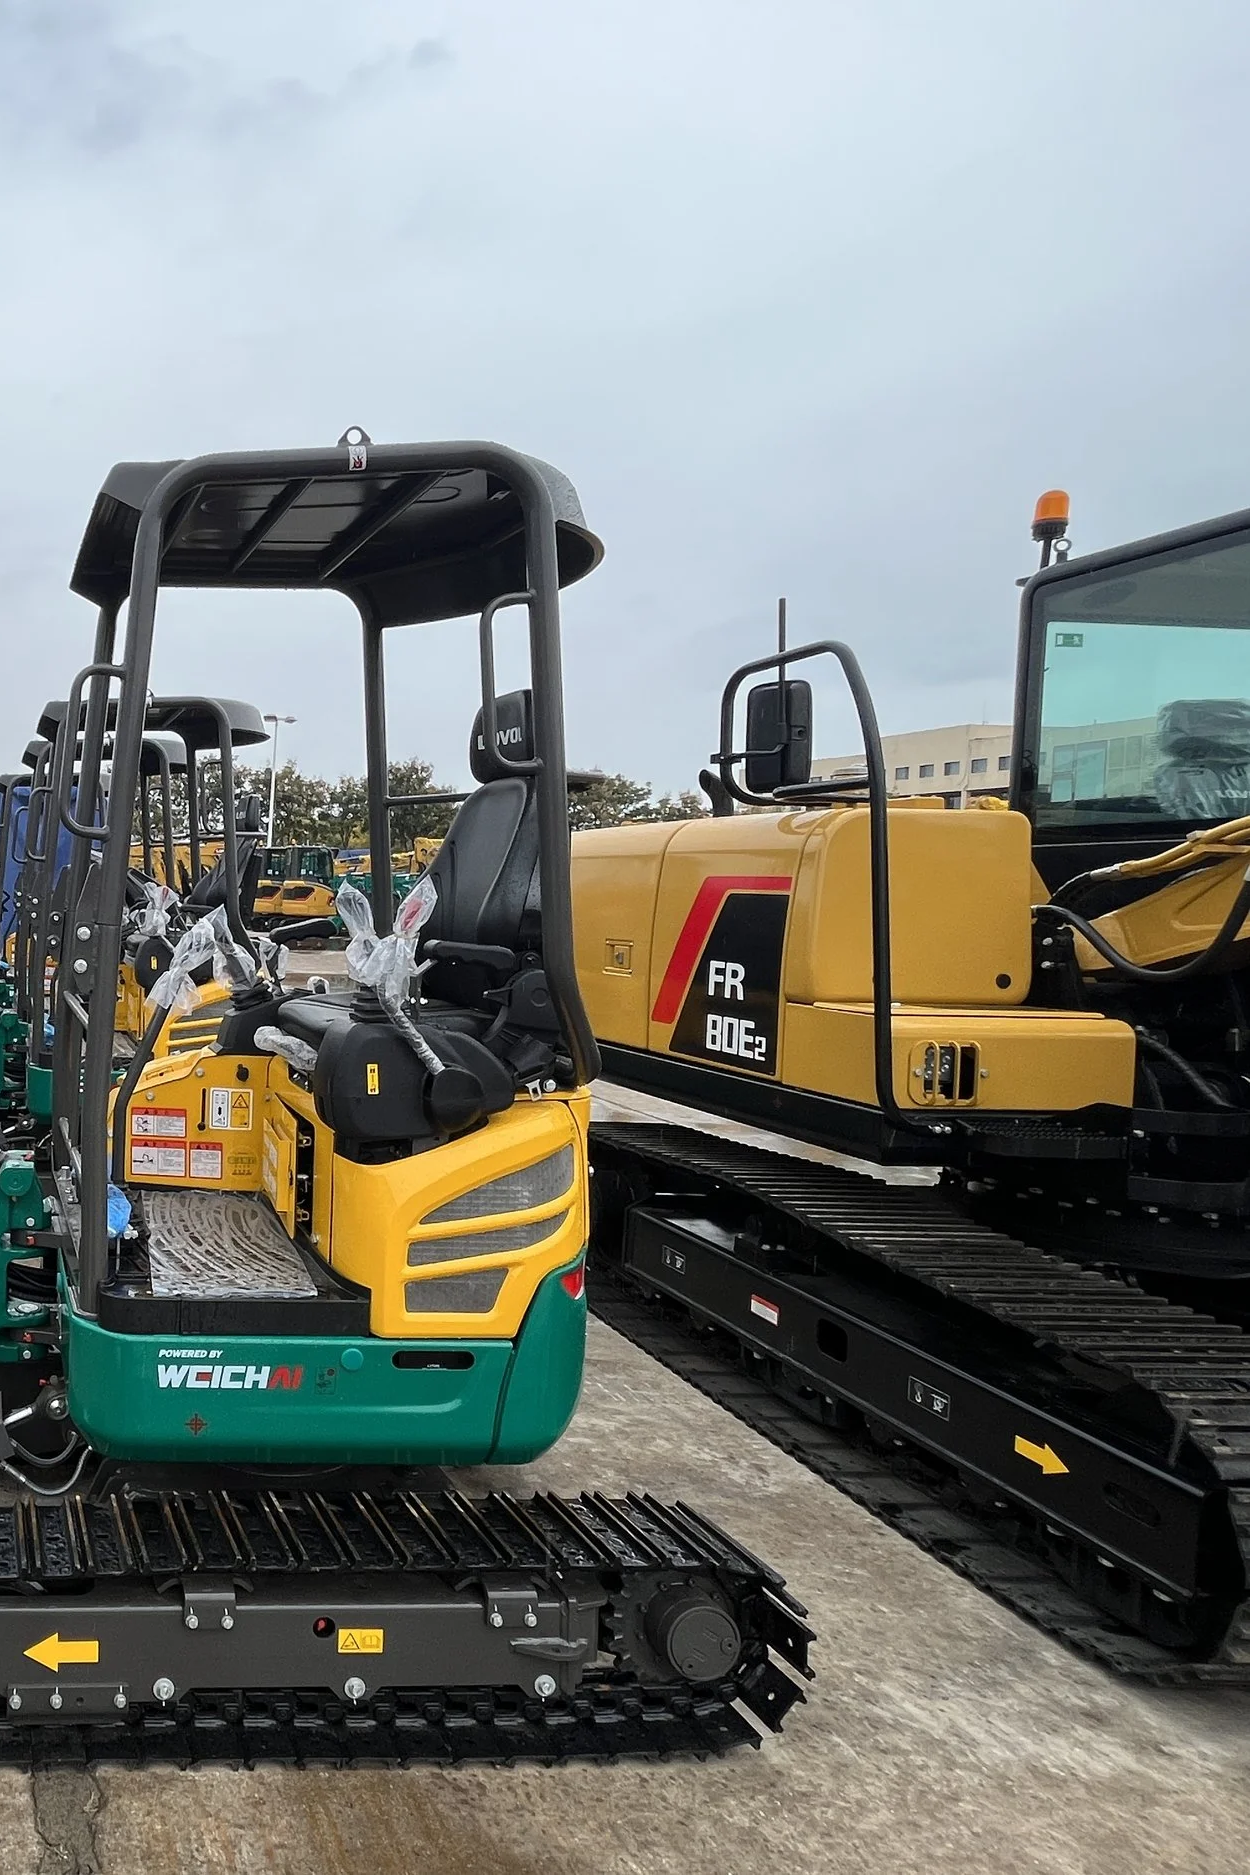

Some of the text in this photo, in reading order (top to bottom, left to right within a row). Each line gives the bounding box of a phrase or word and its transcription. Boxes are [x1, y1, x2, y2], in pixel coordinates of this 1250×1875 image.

[477, 726, 523, 750] LVOL
[708, 960, 745, 1001] FR
[158, 1349, 223, 1359] POWERED BY
[157, 1364, 303, 1389] WEICHAI
